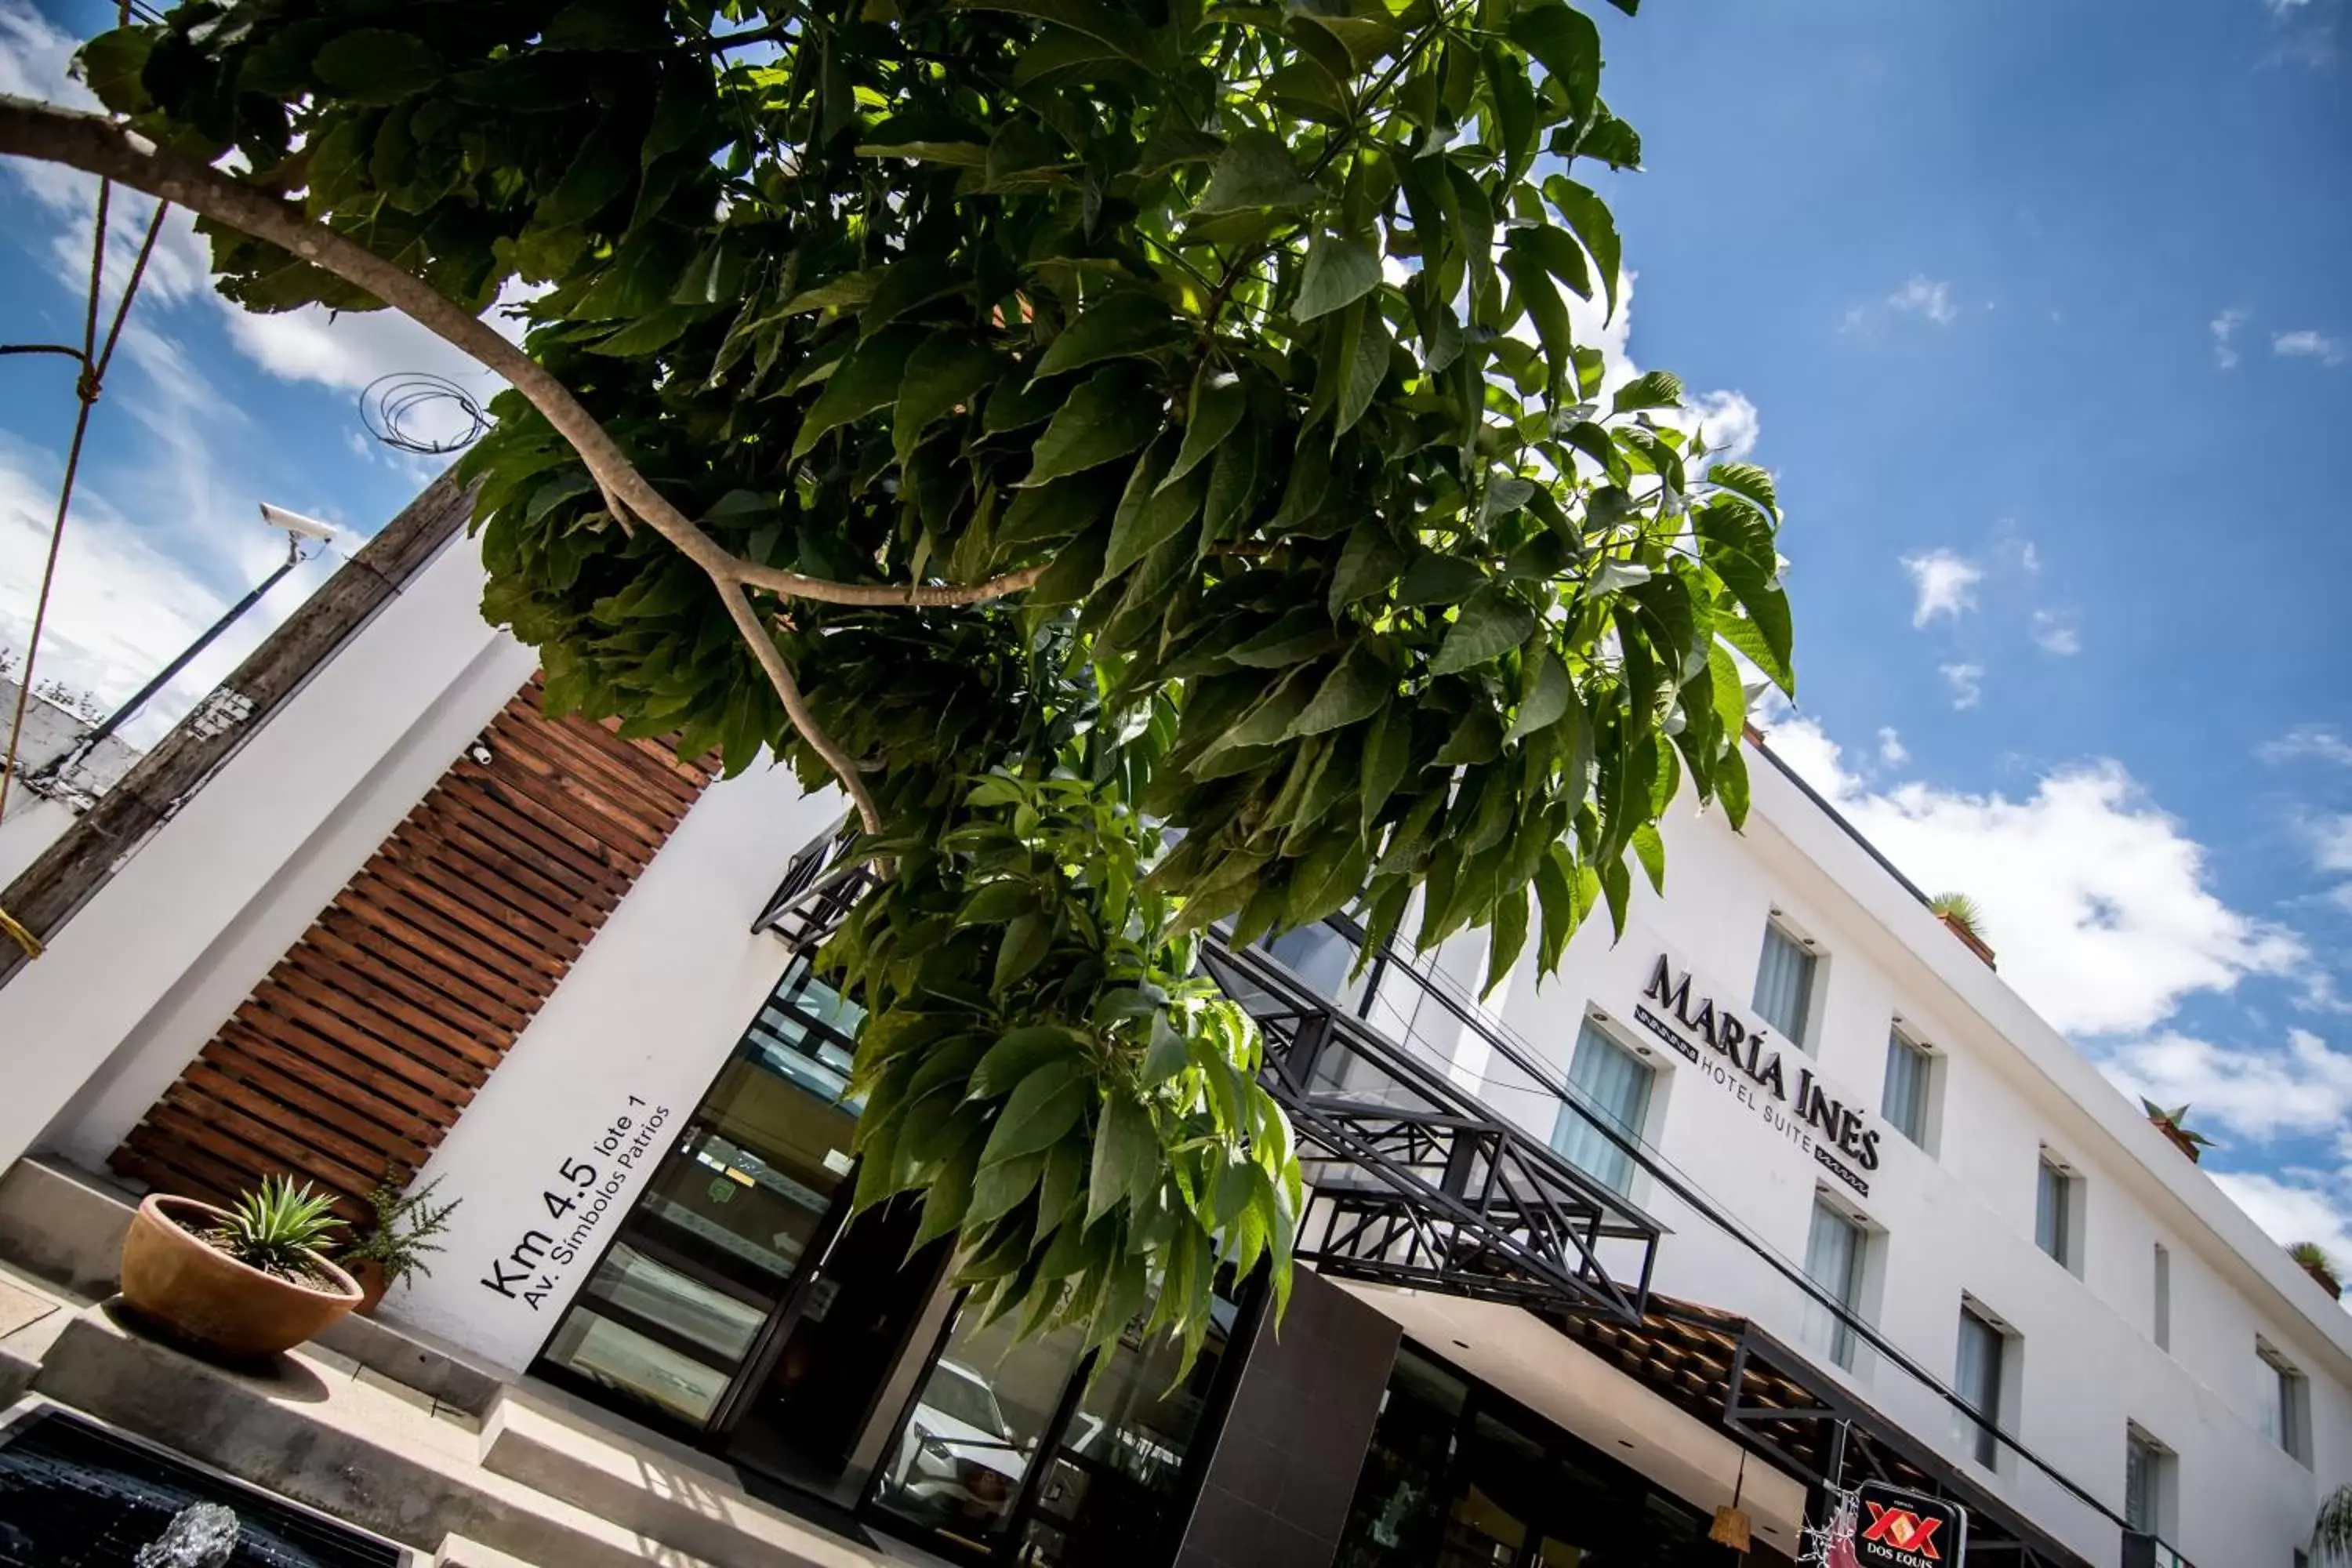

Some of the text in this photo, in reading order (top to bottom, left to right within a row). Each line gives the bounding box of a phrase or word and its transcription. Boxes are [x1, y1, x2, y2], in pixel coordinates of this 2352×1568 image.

[1643, 953, 1880, 1171] MARÍA INÉS
[1701, 1056, 1811, 1153] HOTEL SUITE
[480, 1094, 646, 1299] Km 4.5 lote 1
[523, 1275, 559, 1311] Av.
[617, 1105, 670, 1169] Patrios
[1867, 1542, 1933, 1568] DOS EQUIS
